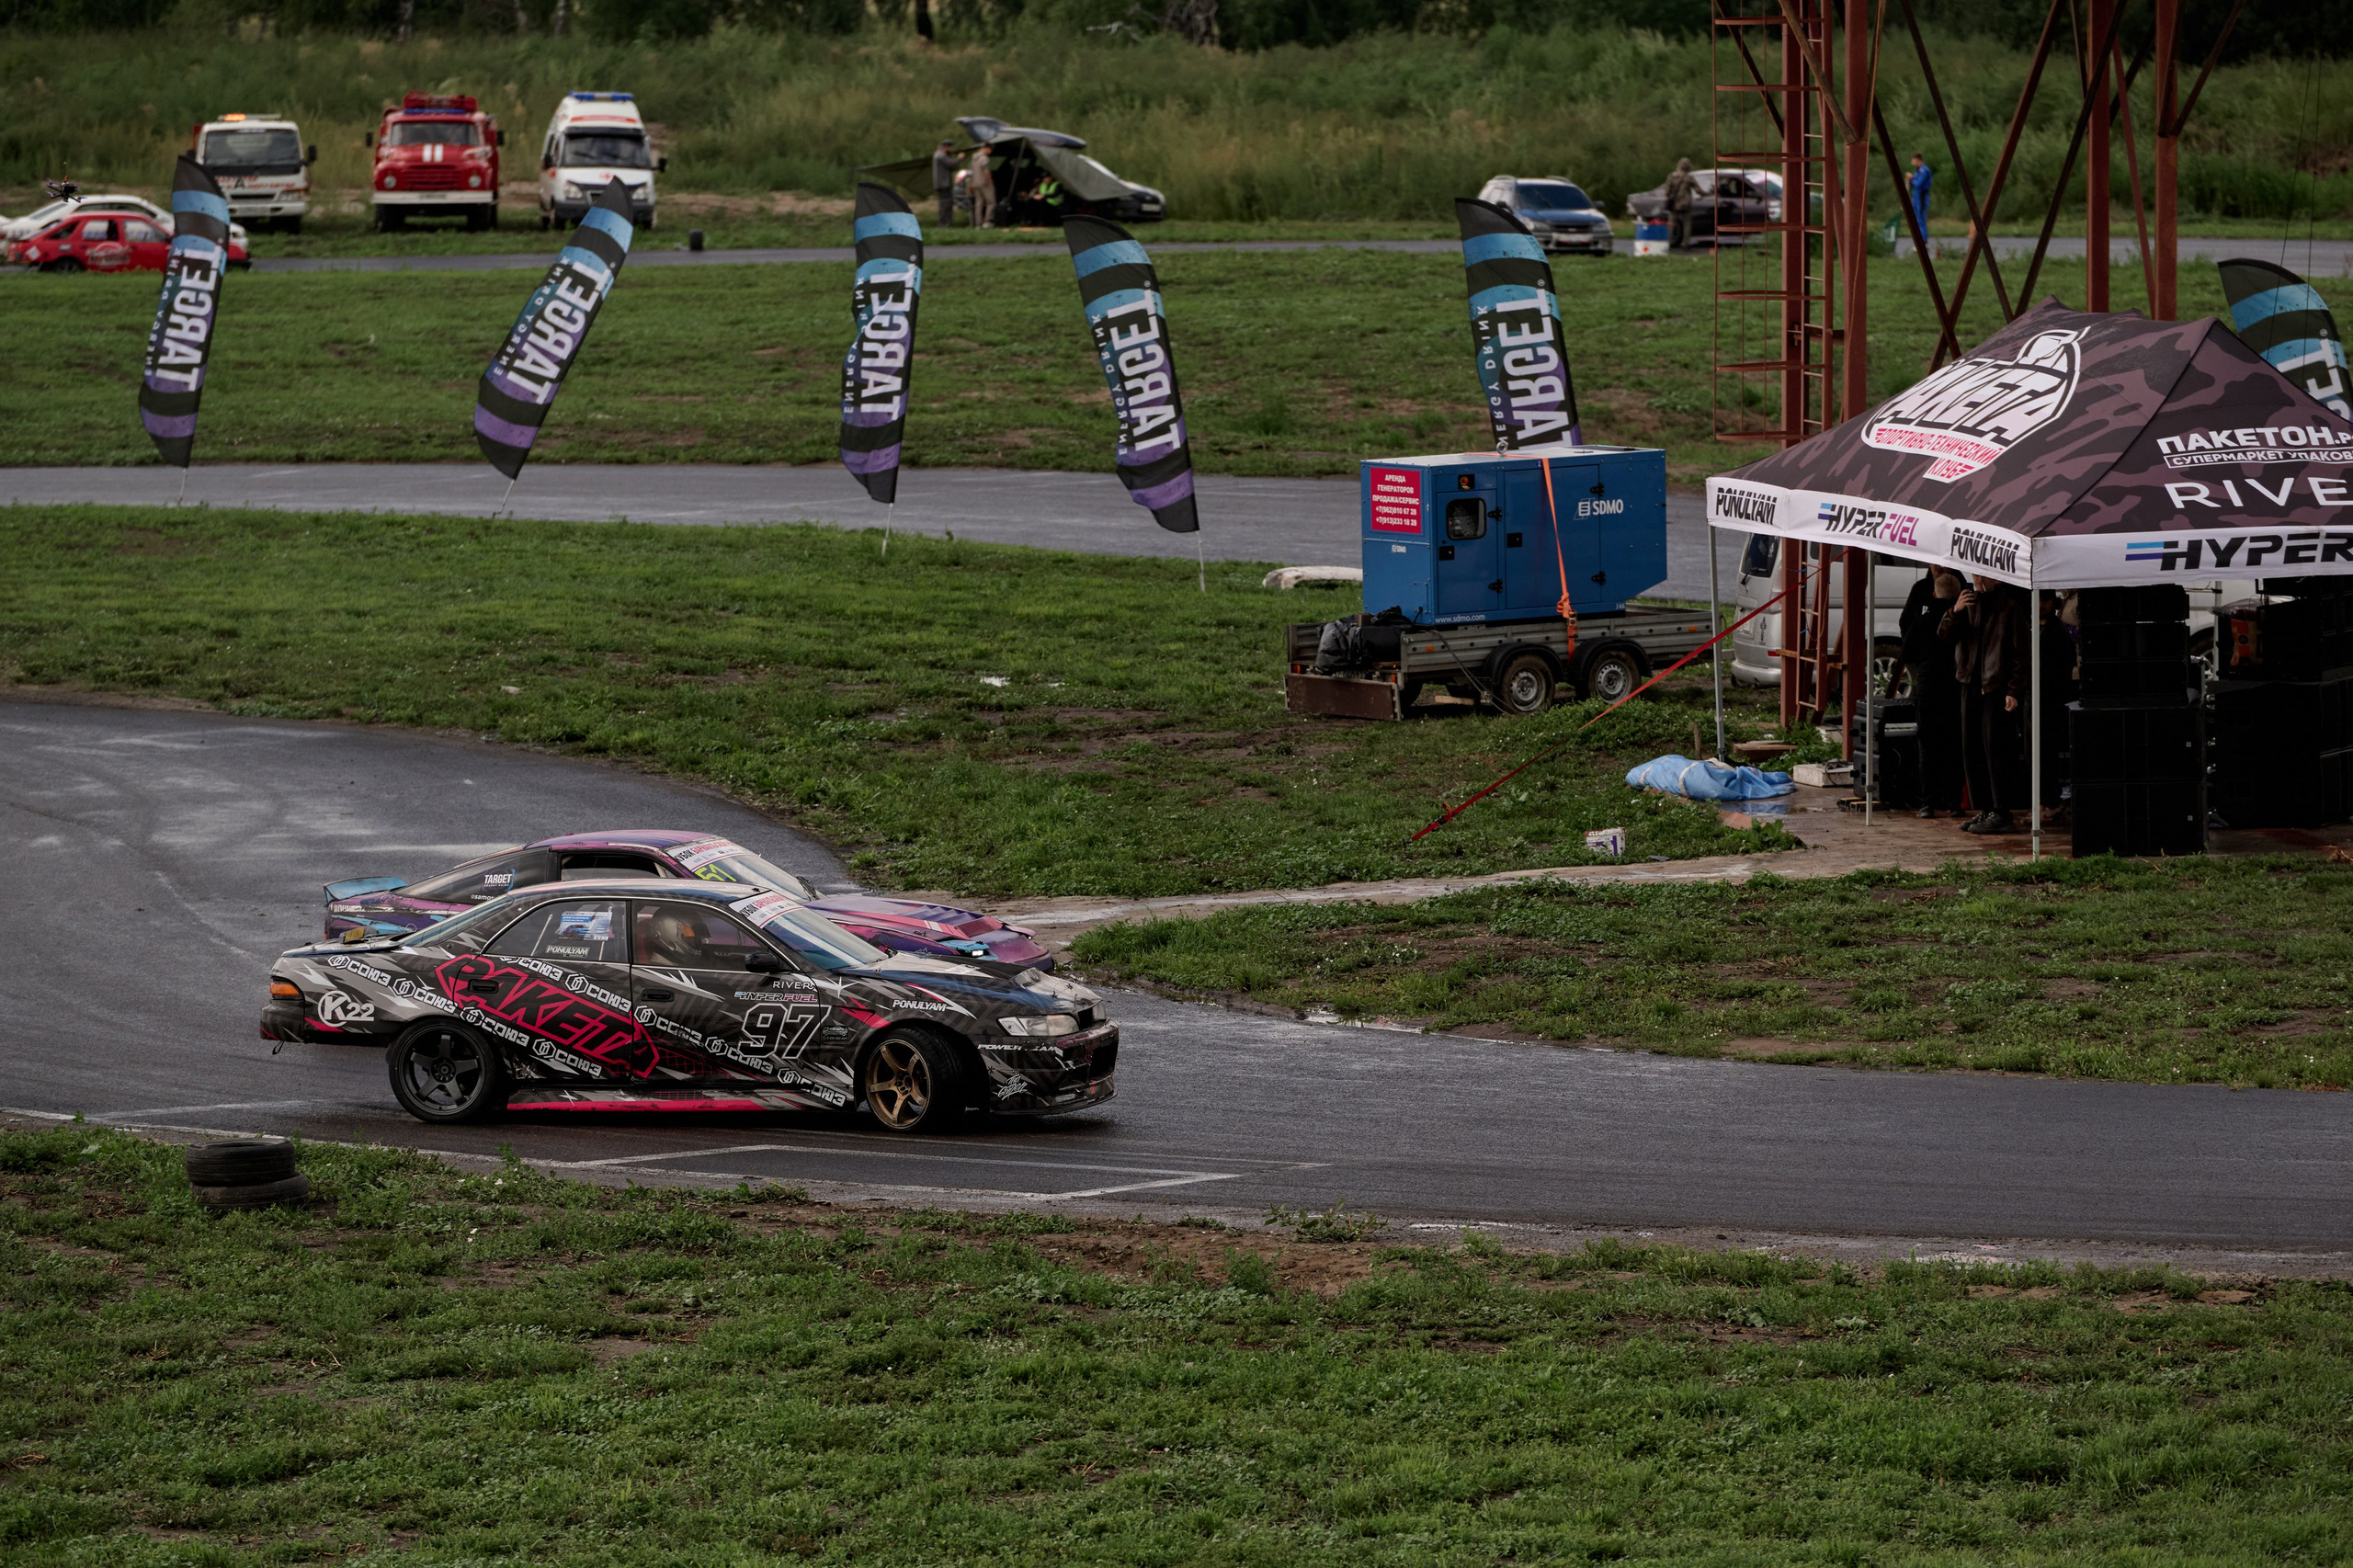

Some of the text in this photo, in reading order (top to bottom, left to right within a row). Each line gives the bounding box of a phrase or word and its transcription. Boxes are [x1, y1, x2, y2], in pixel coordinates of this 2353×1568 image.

[1878, 428, 2004, 466] СПОРТИВНО-ТЕХНИЧЕСКИЙ
[2156, 426, 2353, 454] ПАКЕТОН.Р
[2172, 450, 2353, 466] СУПЕРМАРКЕТ УПАКОВ
[1927, 458, 1963, 479] КЛУБ
[1384, 474, 1406, 483] АРЕНДА
[1377, 484, 1414, 494] ГЕНЕРАТОРОВ
[1372, 494, 1419, 505] ПРОДАЖА/СЕРВИС
[1592, 498, 1624, 516] SDMO
[1715, 487, 1777, 525] PONULYAM
[1950, 527, 2020, 574] PONULYAM
[1435, 614, 1485, 623] www.sdmo.com
[484, 874, 512, 883] TARGET
[694, 863, 736, 882] 51
[547, 946, 589, 955] PONULYAM
[892, 999, 948, 1012] PONULYAM
[737, 1003, 832, 1060] 97
